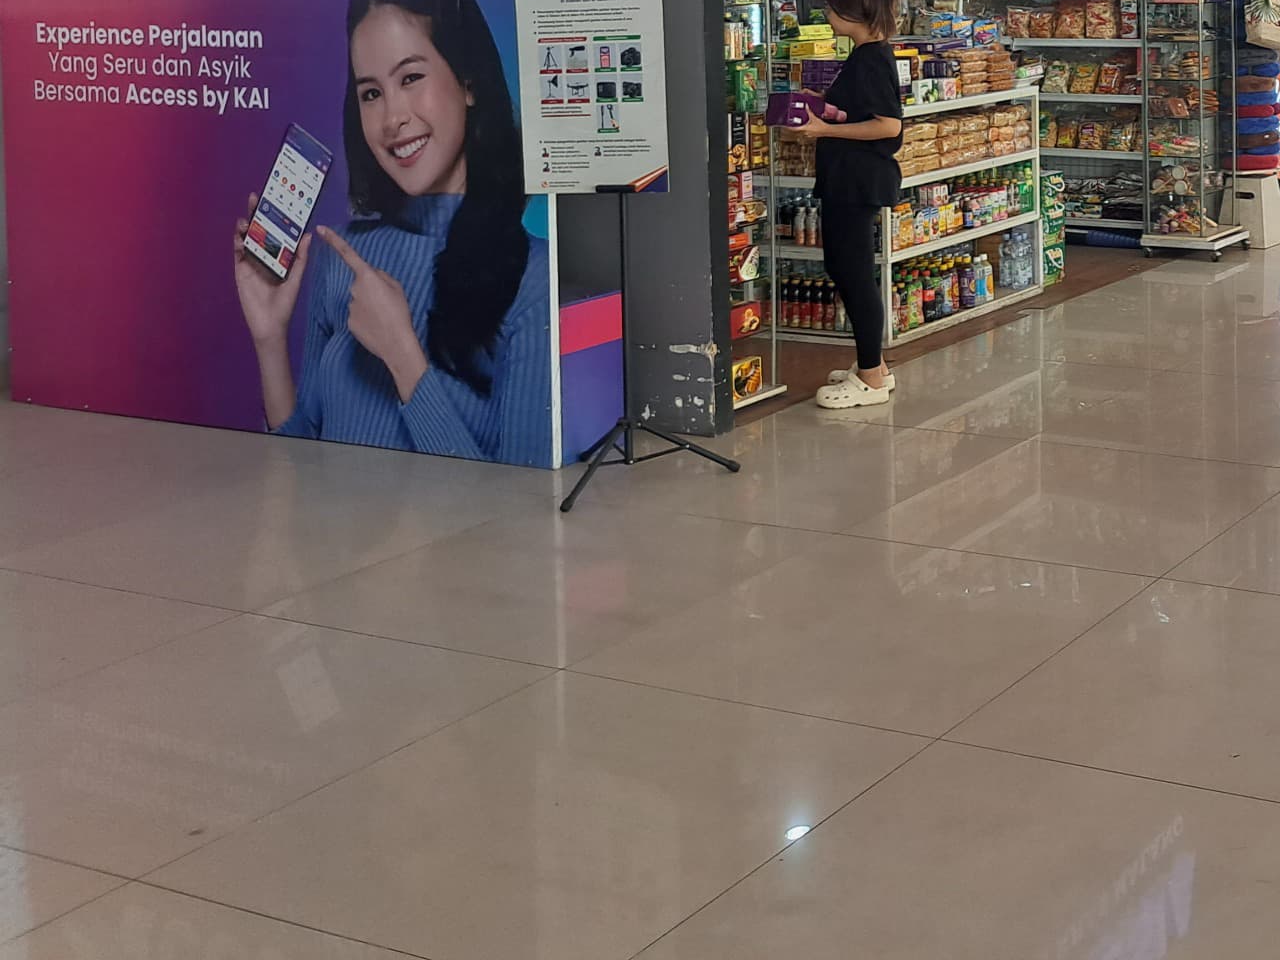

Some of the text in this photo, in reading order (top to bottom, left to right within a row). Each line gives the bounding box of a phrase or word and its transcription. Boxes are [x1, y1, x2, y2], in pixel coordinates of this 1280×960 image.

[35, 23, 264, 53] Experience Perjalanan
[49, 51, 252, 81] Yang Seru dan Asyik
[34, 80, 270, 115] Bersama Access by KAI
